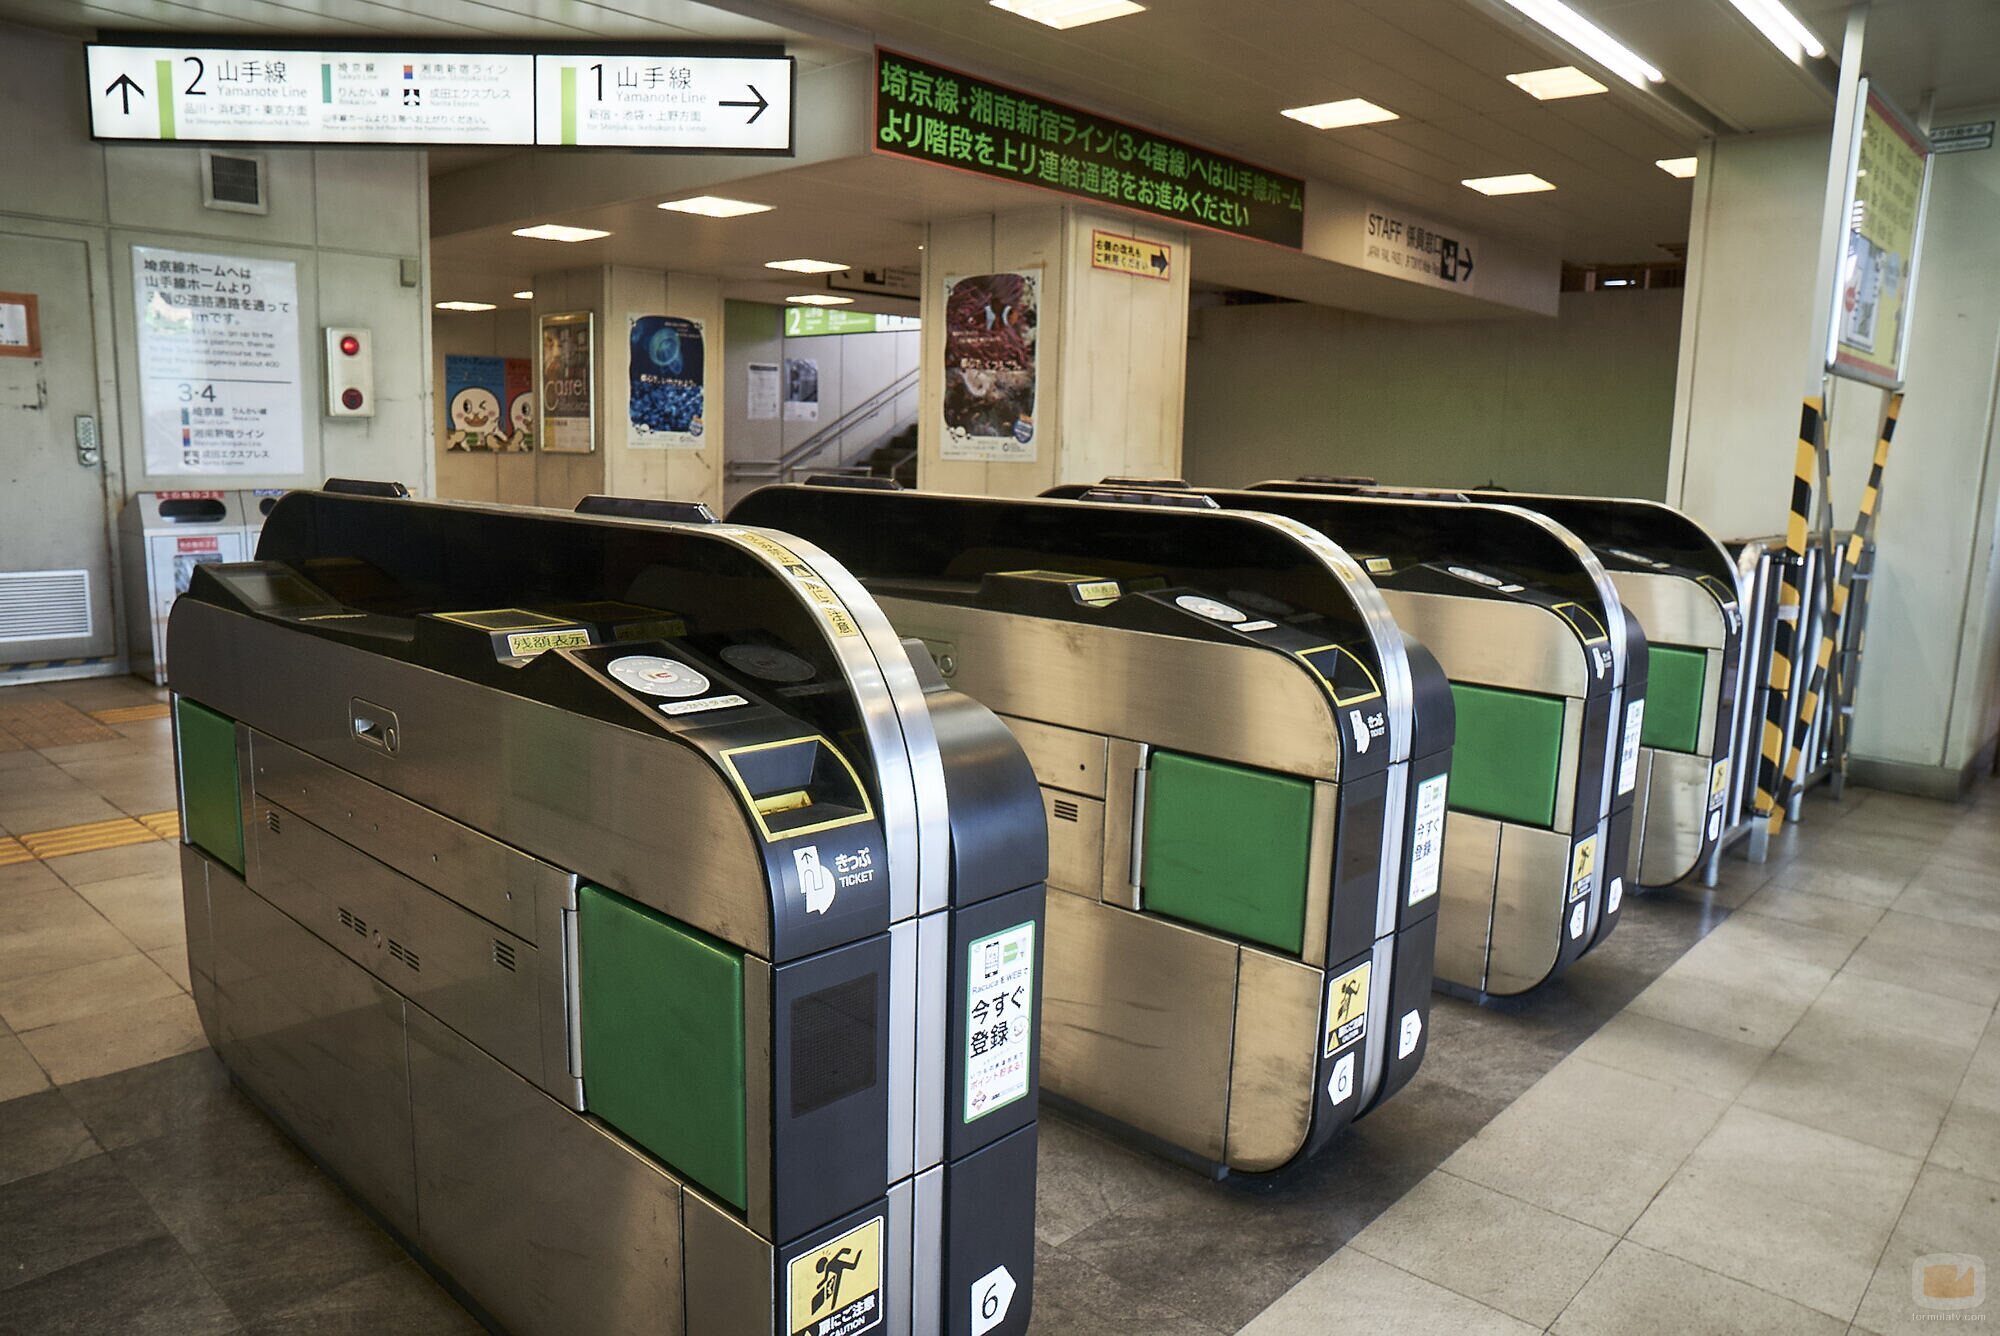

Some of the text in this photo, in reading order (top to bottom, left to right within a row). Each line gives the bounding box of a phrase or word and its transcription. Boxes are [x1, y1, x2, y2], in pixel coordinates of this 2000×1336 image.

[184, 56, 207, 95] 2
[217, 59, 287, 84] 山手線
[590, 64, 602, 101] 1
[617, 66, 692, 90] 山手線
[217, 85, 307, 97] Yamanote Line
[430, 88, 511, 100] 成田エクスプレス
[616, 91, 707, 104] Yamanote Line
[880, 108, 1250, 226] より階段を上り連絡通路をお進みください
[1368, 213, 1402, 242] STAFF
[144, 259, 252, 280] 埼京線ホームへは
[145, 275, 252, 295] 山手線ホームより
[513, 633, 587, 650] 残額表示
[834, 847, 872, 873] きっぷ
[839, 869, 875, 888] TICKET
[972, 985, 1025, 1025] 今すぐ
[970, 1021, 1009, 1059] 登録
[1405, 1022, 1413, 1046] 5
[1338, 1065, 1347, 1093] 6
[982, 1282, 999, 1320] 6
